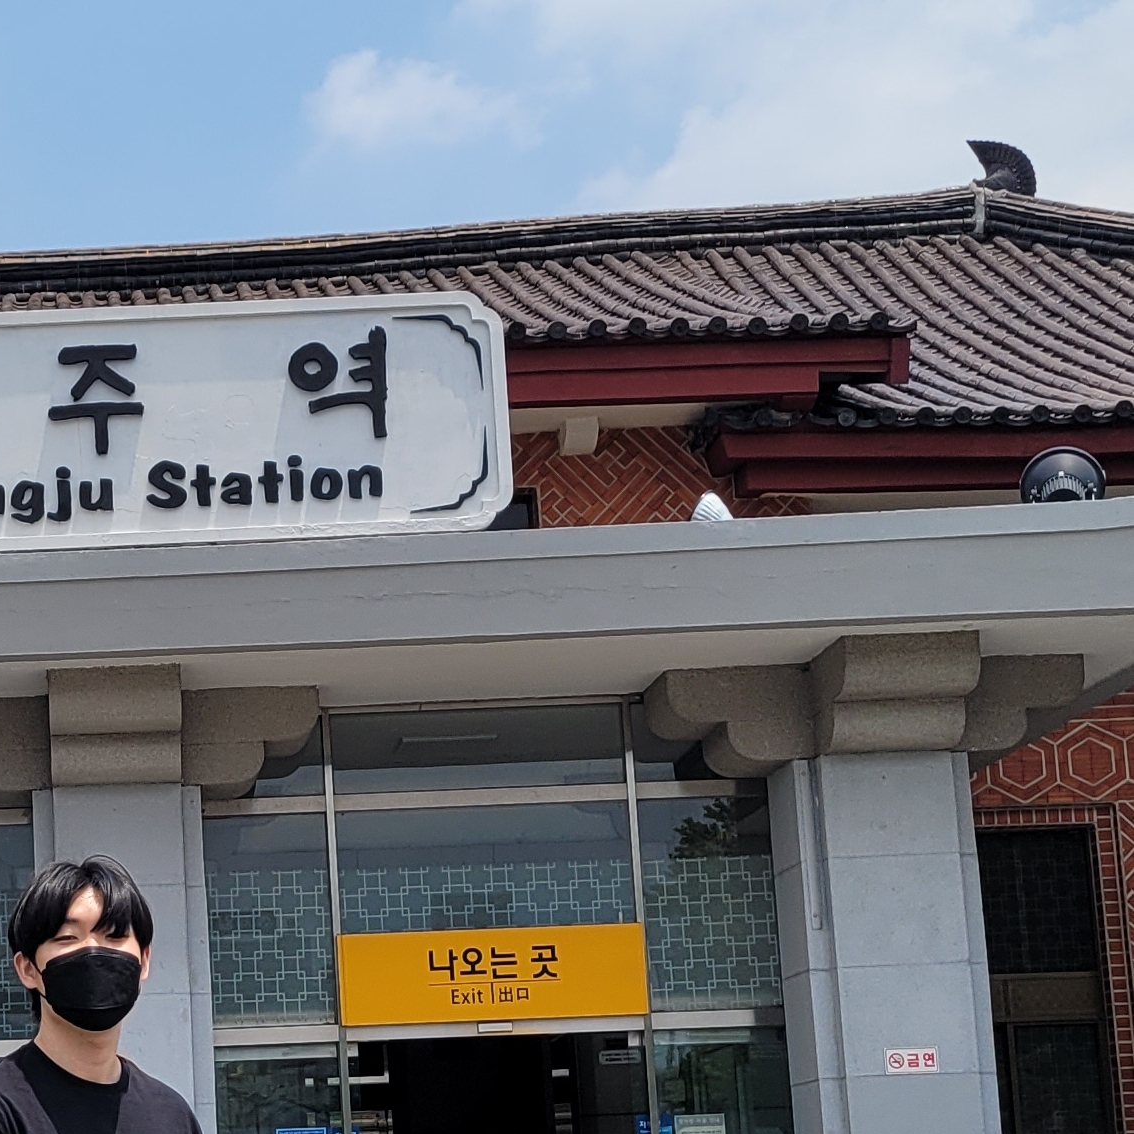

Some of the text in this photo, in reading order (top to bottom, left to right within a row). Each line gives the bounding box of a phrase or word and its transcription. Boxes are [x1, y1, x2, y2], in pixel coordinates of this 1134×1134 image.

[48, 344, 144, 456] 주
[288, 326, 388, 438] 역
[146, 455, 383, 510] Station
[428, 945, 559, 981] 나오는 곳
[451, 987, 484, 1005] Exit
[498, 986, 530, 1003] 出口
[907, 1052, 935, 1067] 금연
